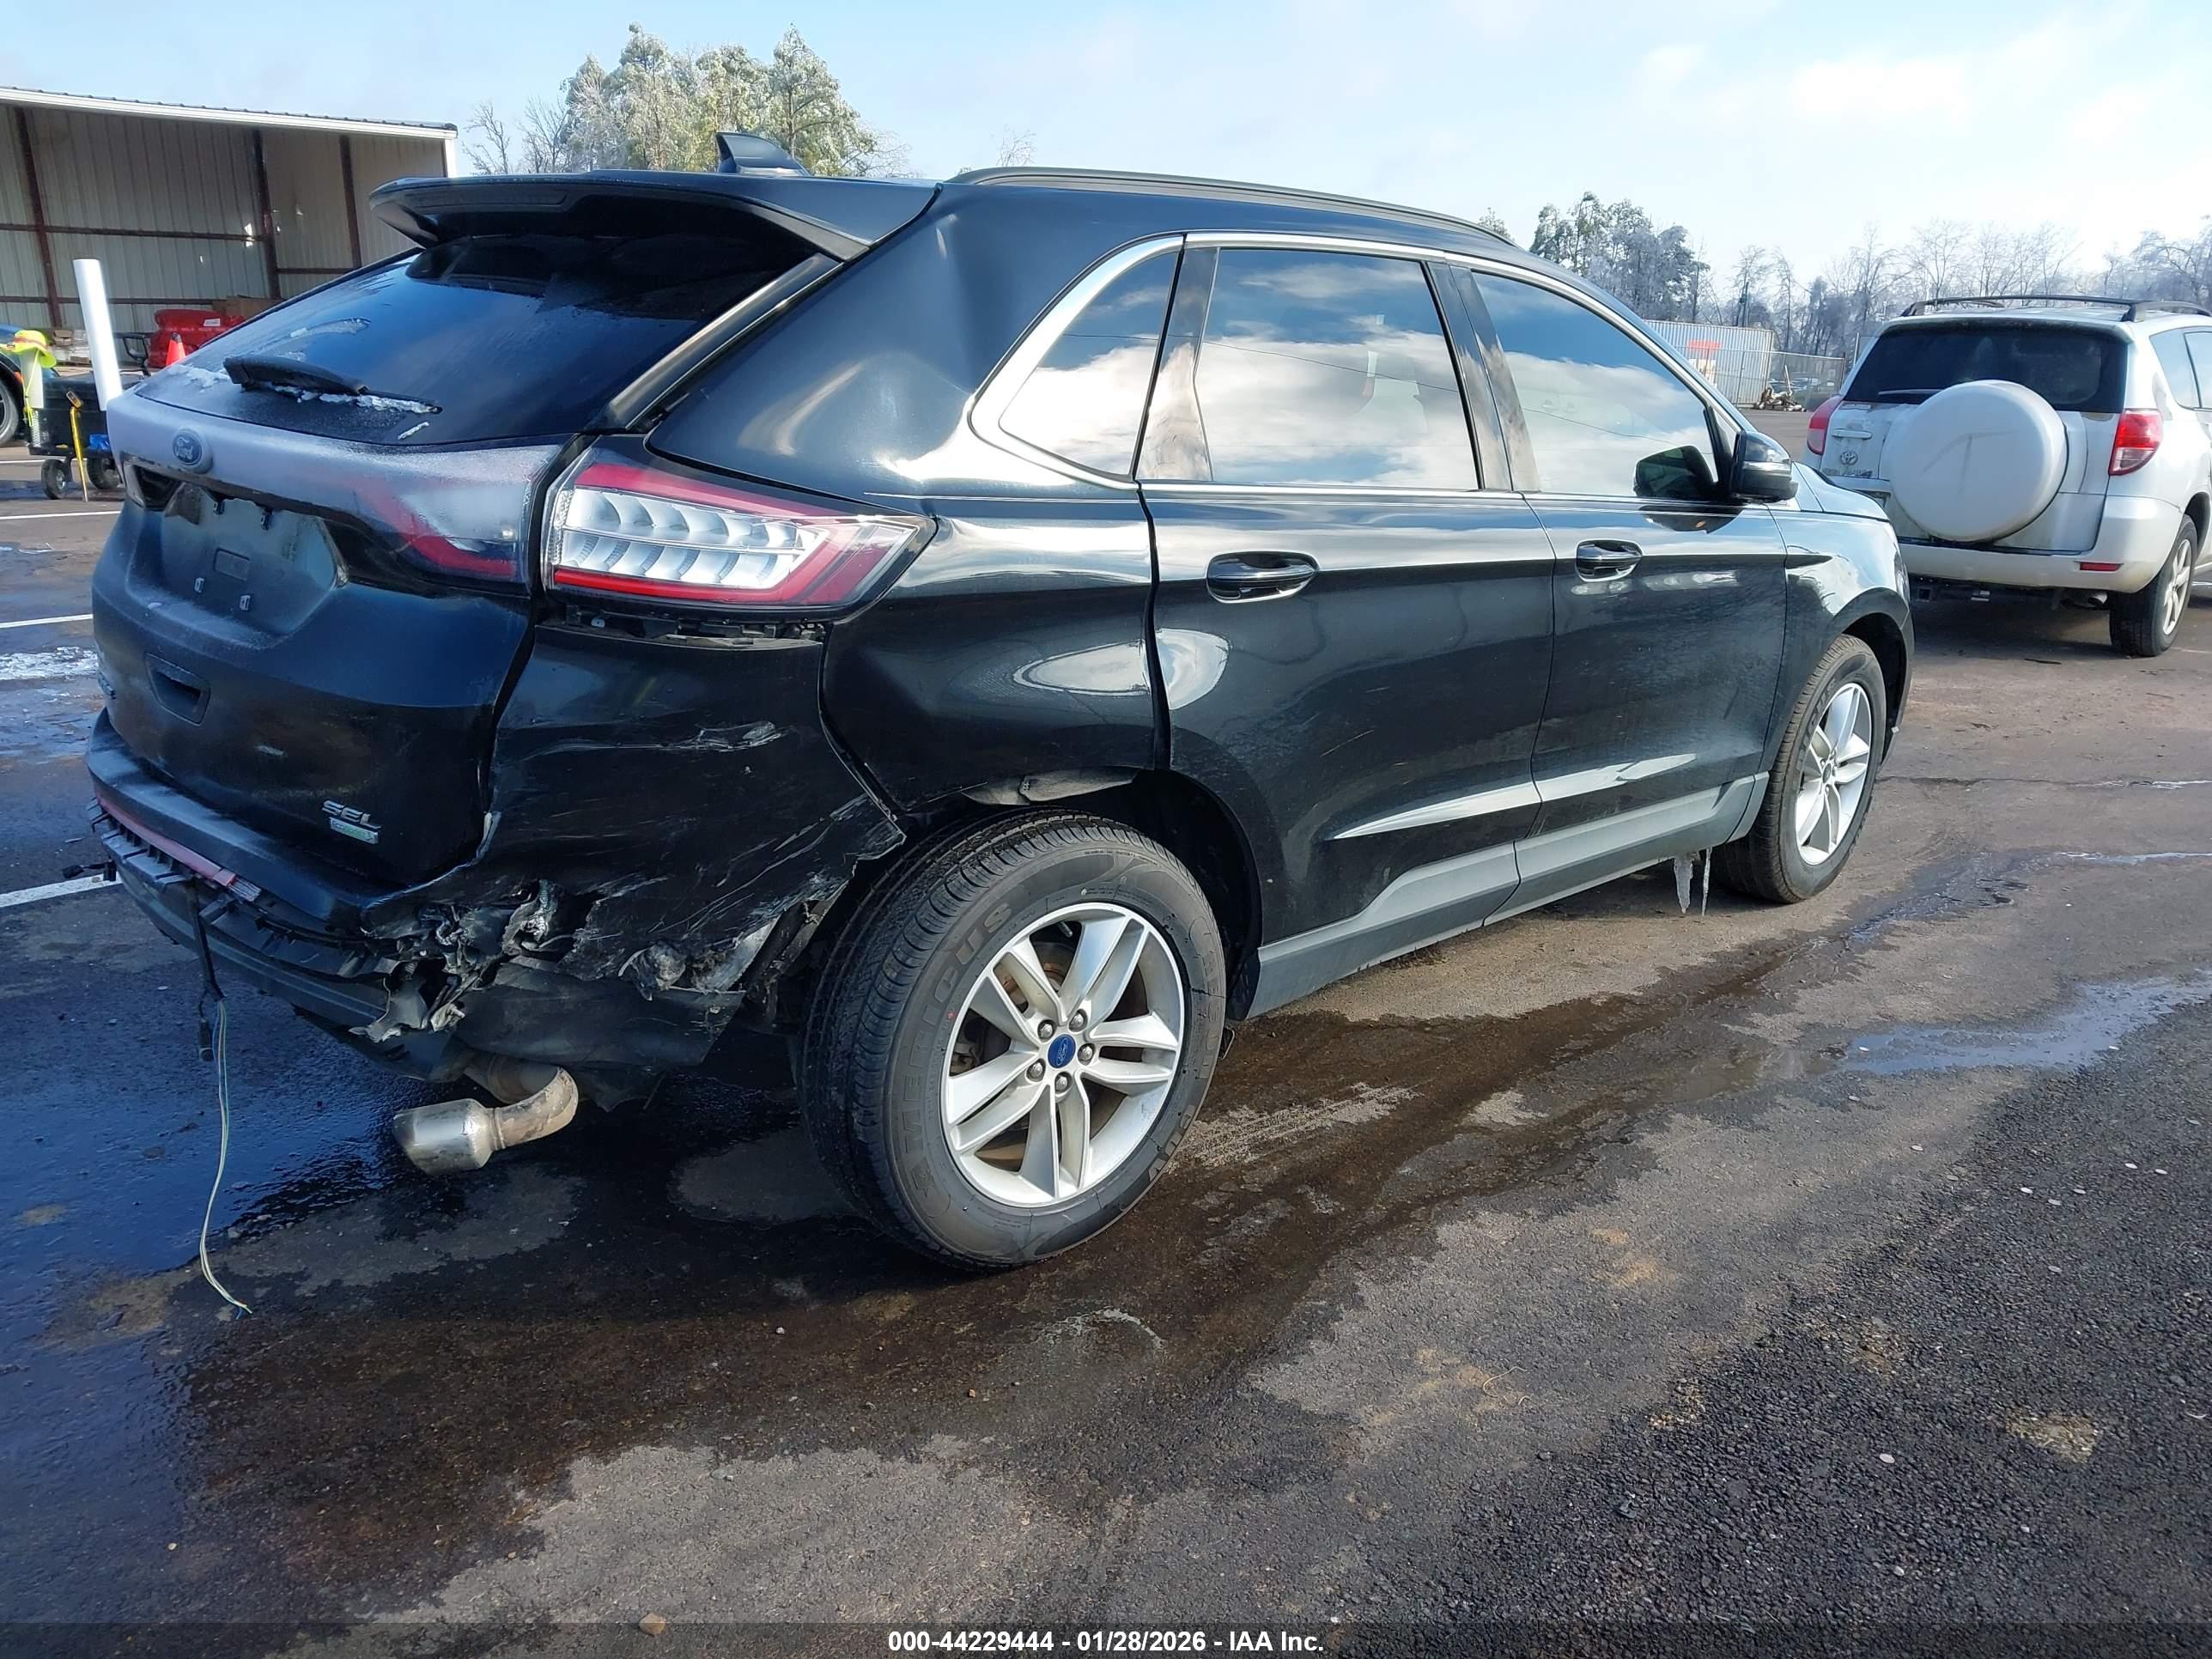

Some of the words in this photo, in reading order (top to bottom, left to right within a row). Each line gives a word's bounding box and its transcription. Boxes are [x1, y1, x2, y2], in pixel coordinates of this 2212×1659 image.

[175, 436, 194, 460] Ford
[322, 799, 382, 830] SEL
[902, 902, 1012, 1195] AMERICUS
